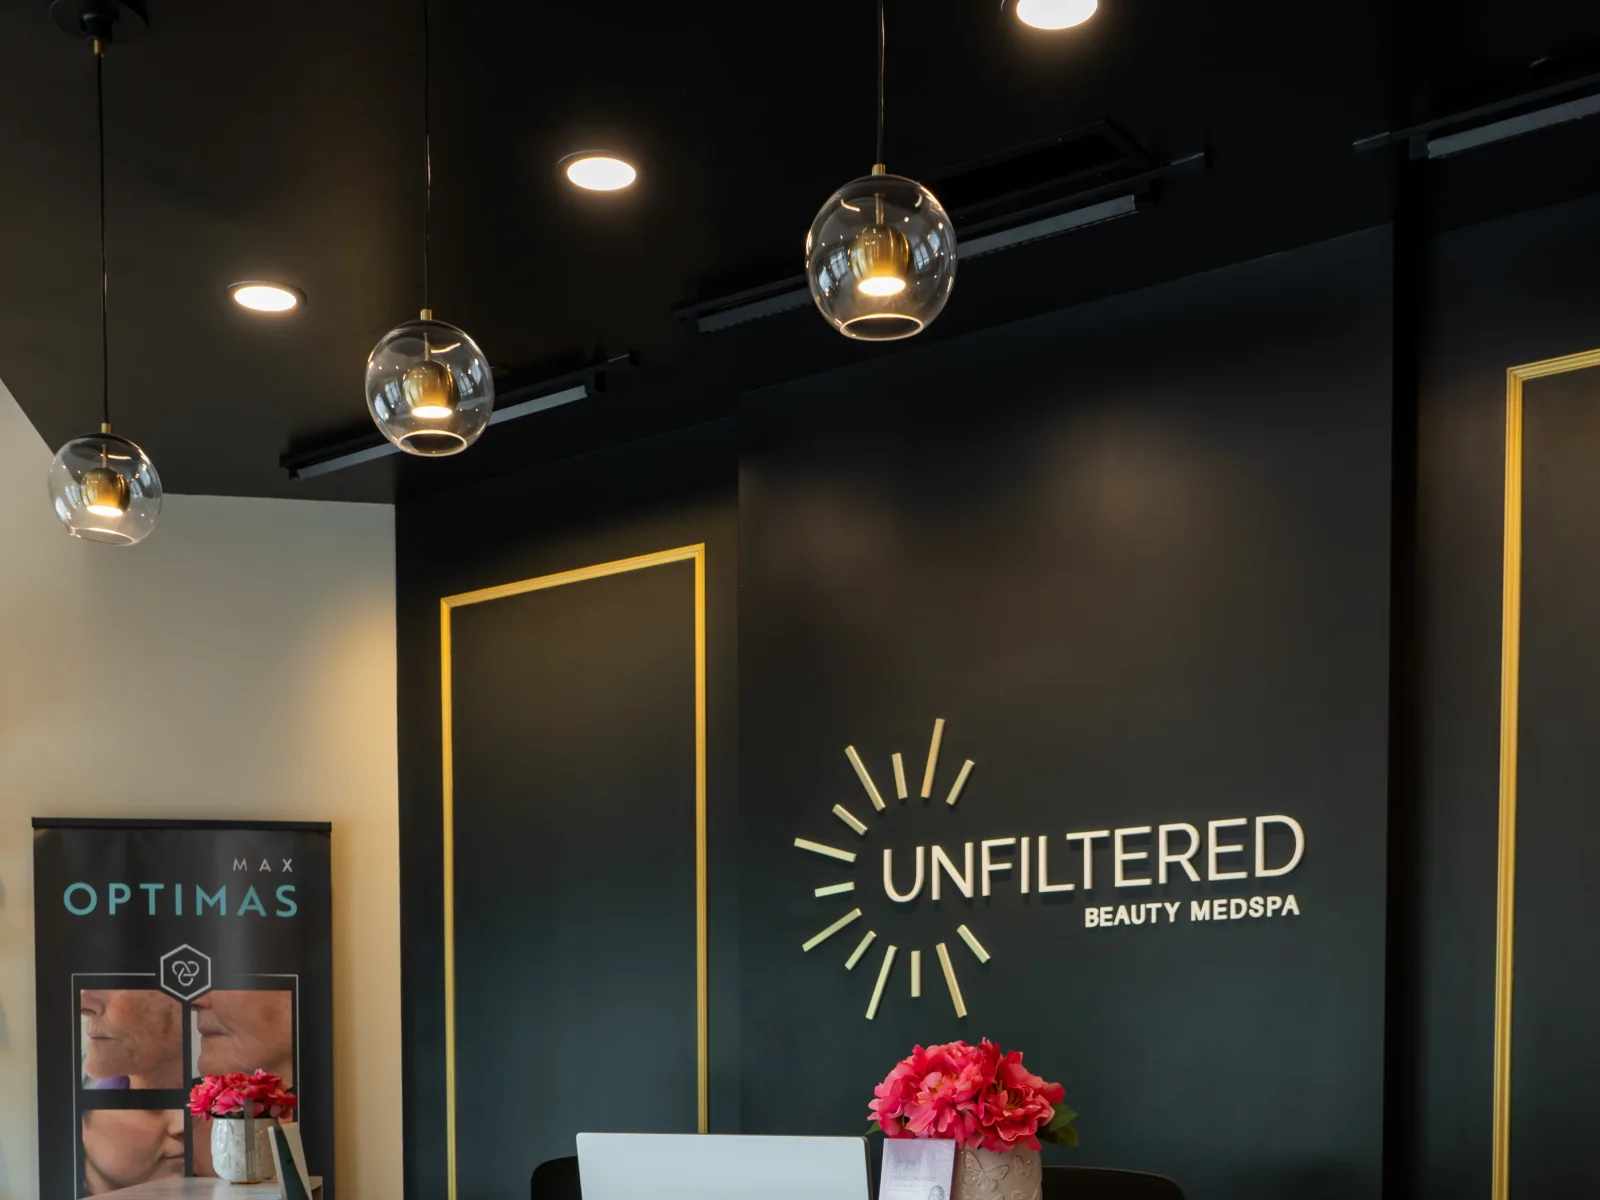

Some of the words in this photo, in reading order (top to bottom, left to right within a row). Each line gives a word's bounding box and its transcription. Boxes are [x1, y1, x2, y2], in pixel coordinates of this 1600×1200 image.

[233, 857, 294, 873] MAX
[883, 814, 1306, 902] UNFILTERED
[63, 882, 298, 918] OPTIMAS
[1084, 901, 1183, 928] BEAUTY
[1190, 894, 1300, 923] MEDSPA
